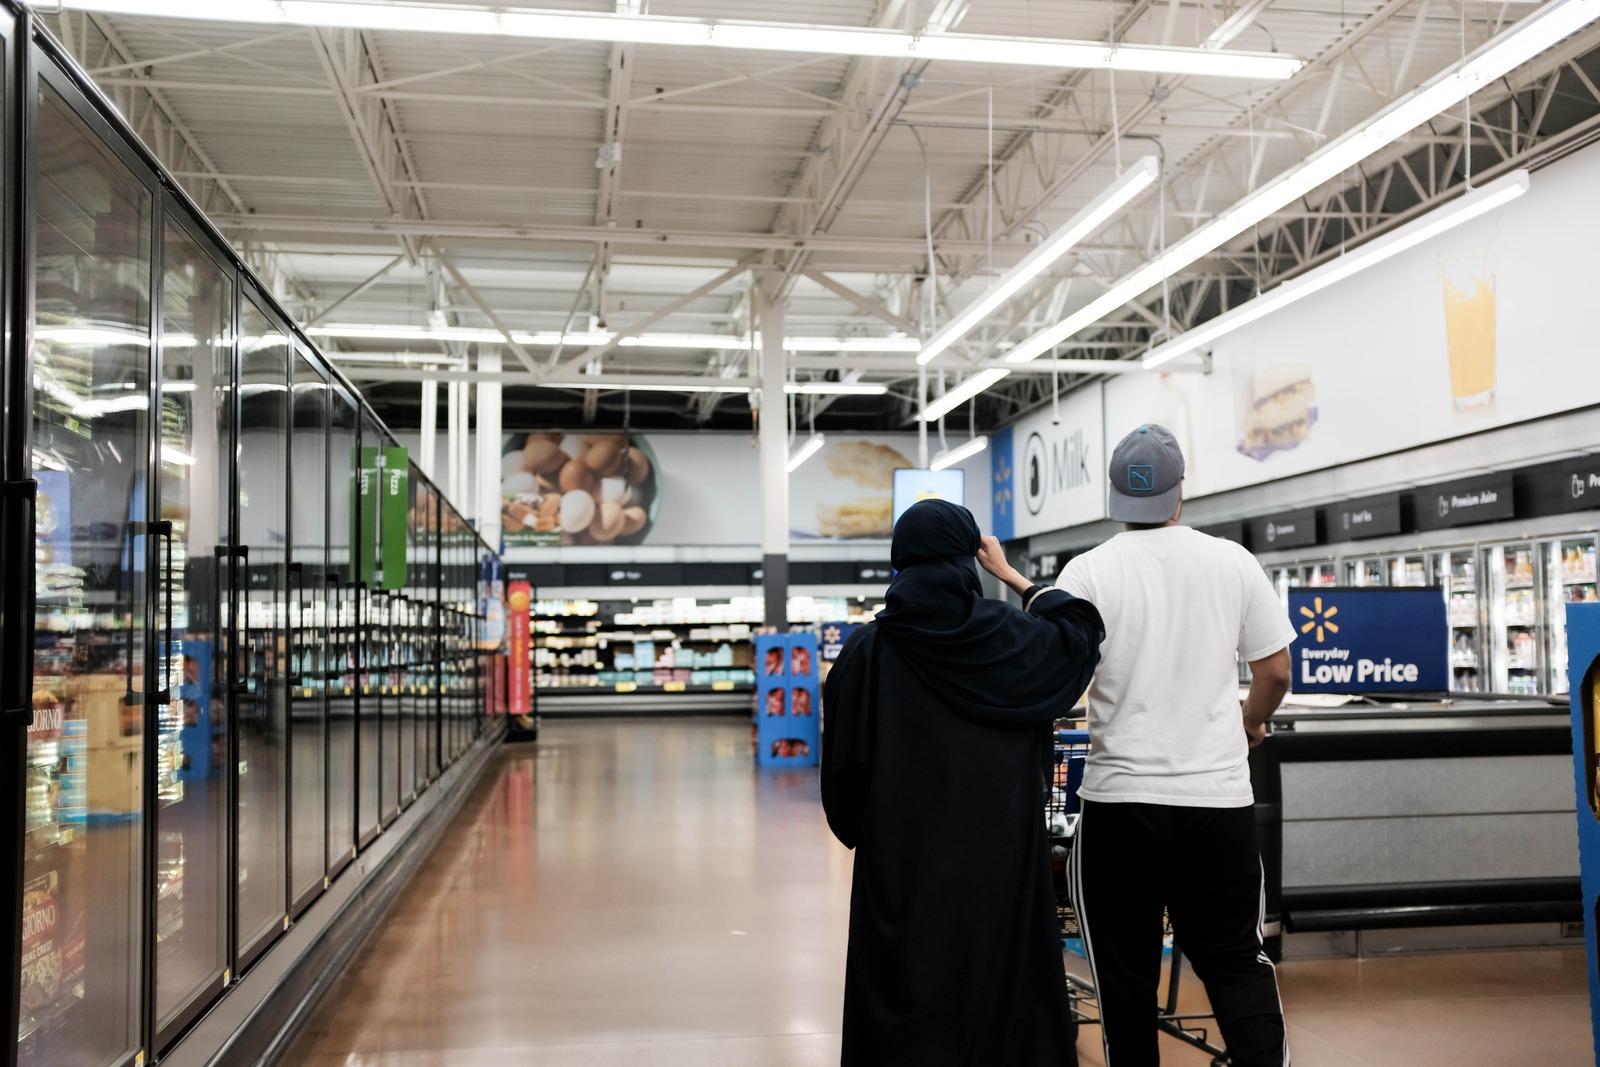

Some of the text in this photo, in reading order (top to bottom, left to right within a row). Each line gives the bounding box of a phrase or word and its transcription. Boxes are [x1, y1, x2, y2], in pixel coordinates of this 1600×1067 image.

[1051, 428, 1091, 495] Milk
[390, 469, 401, 496] Pizza
[1451, 491, 1498, 508] Premium Juice
[1302, 647, 1350, 661] Everyday
[1302, 657, 1419, 684] Low Price
[27, 708, 61, 733] IORNO
